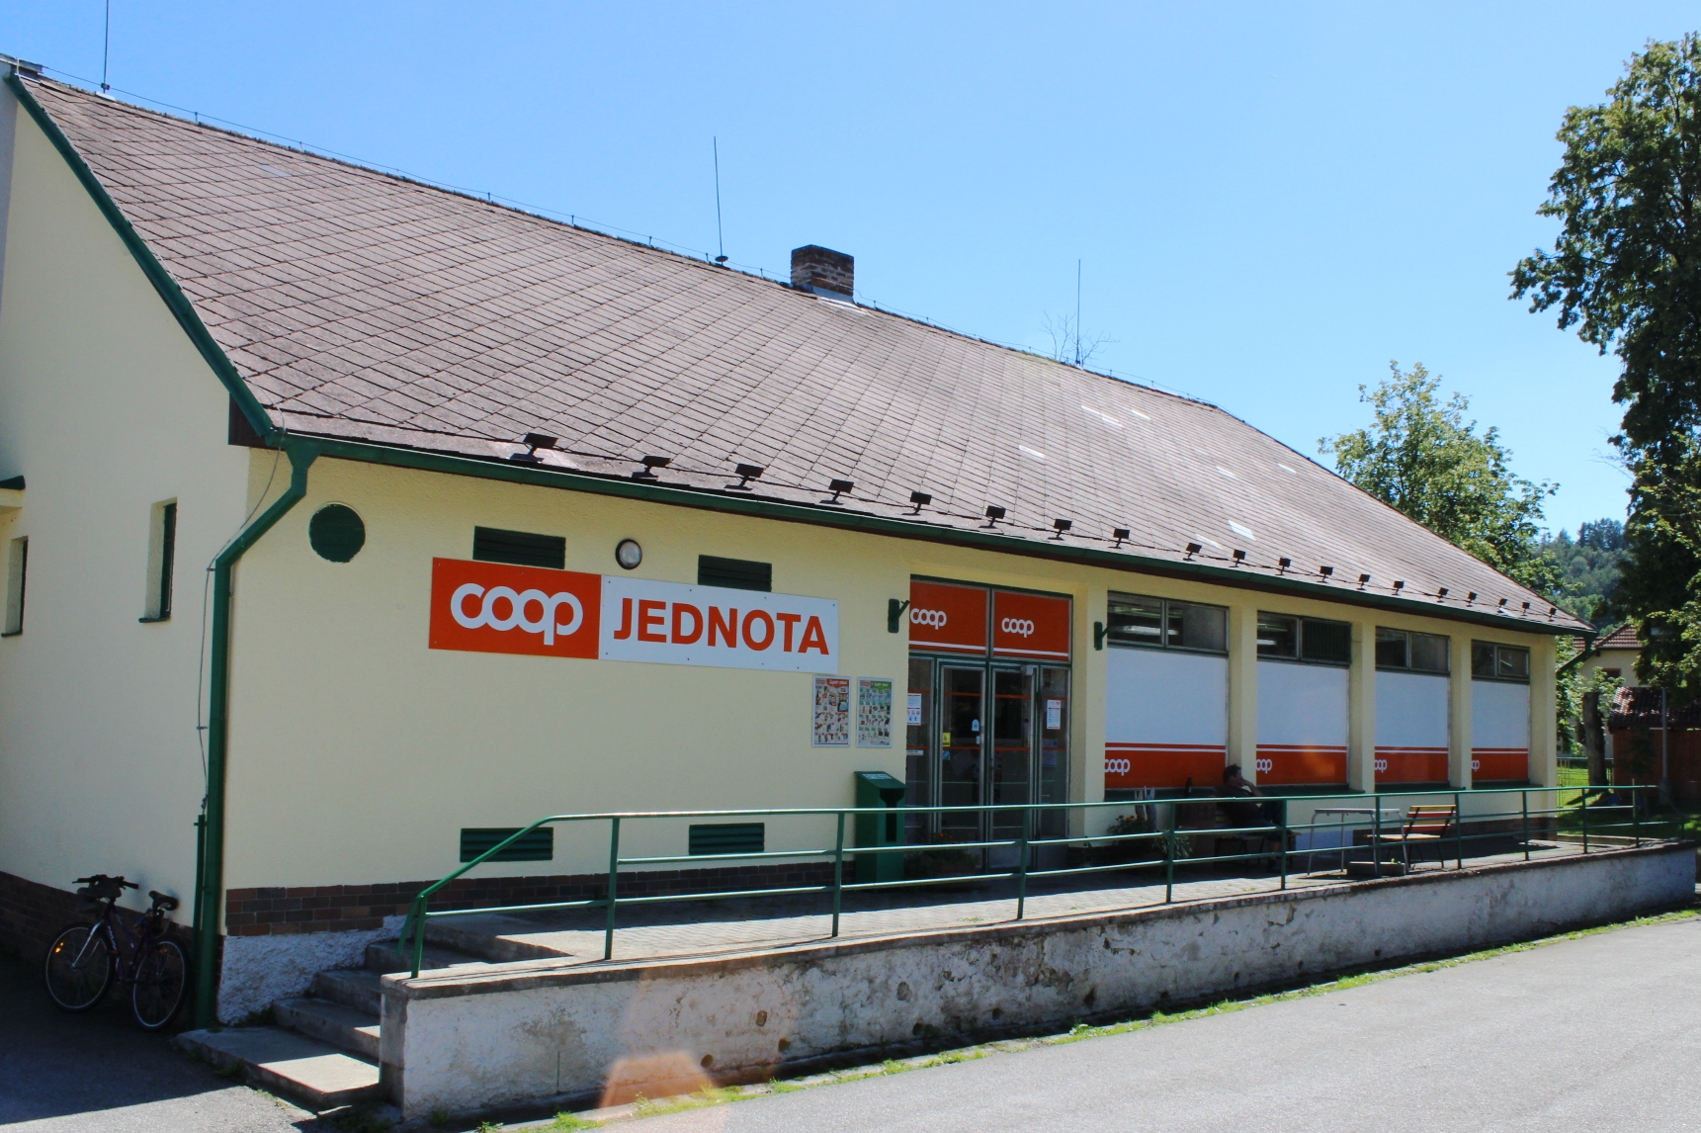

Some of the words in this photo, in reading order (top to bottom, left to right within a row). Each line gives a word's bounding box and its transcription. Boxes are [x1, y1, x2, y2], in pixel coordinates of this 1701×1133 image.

[450, 582, 584, 646] coop
[613, 597, 831, 655] JEDNOTA
[909, 607, 947, 630] coop
[1001, 617, 1035, 638] coop
[1256, 758, 1273, 774] oop
[1374, 759, 1388, 773] oop
